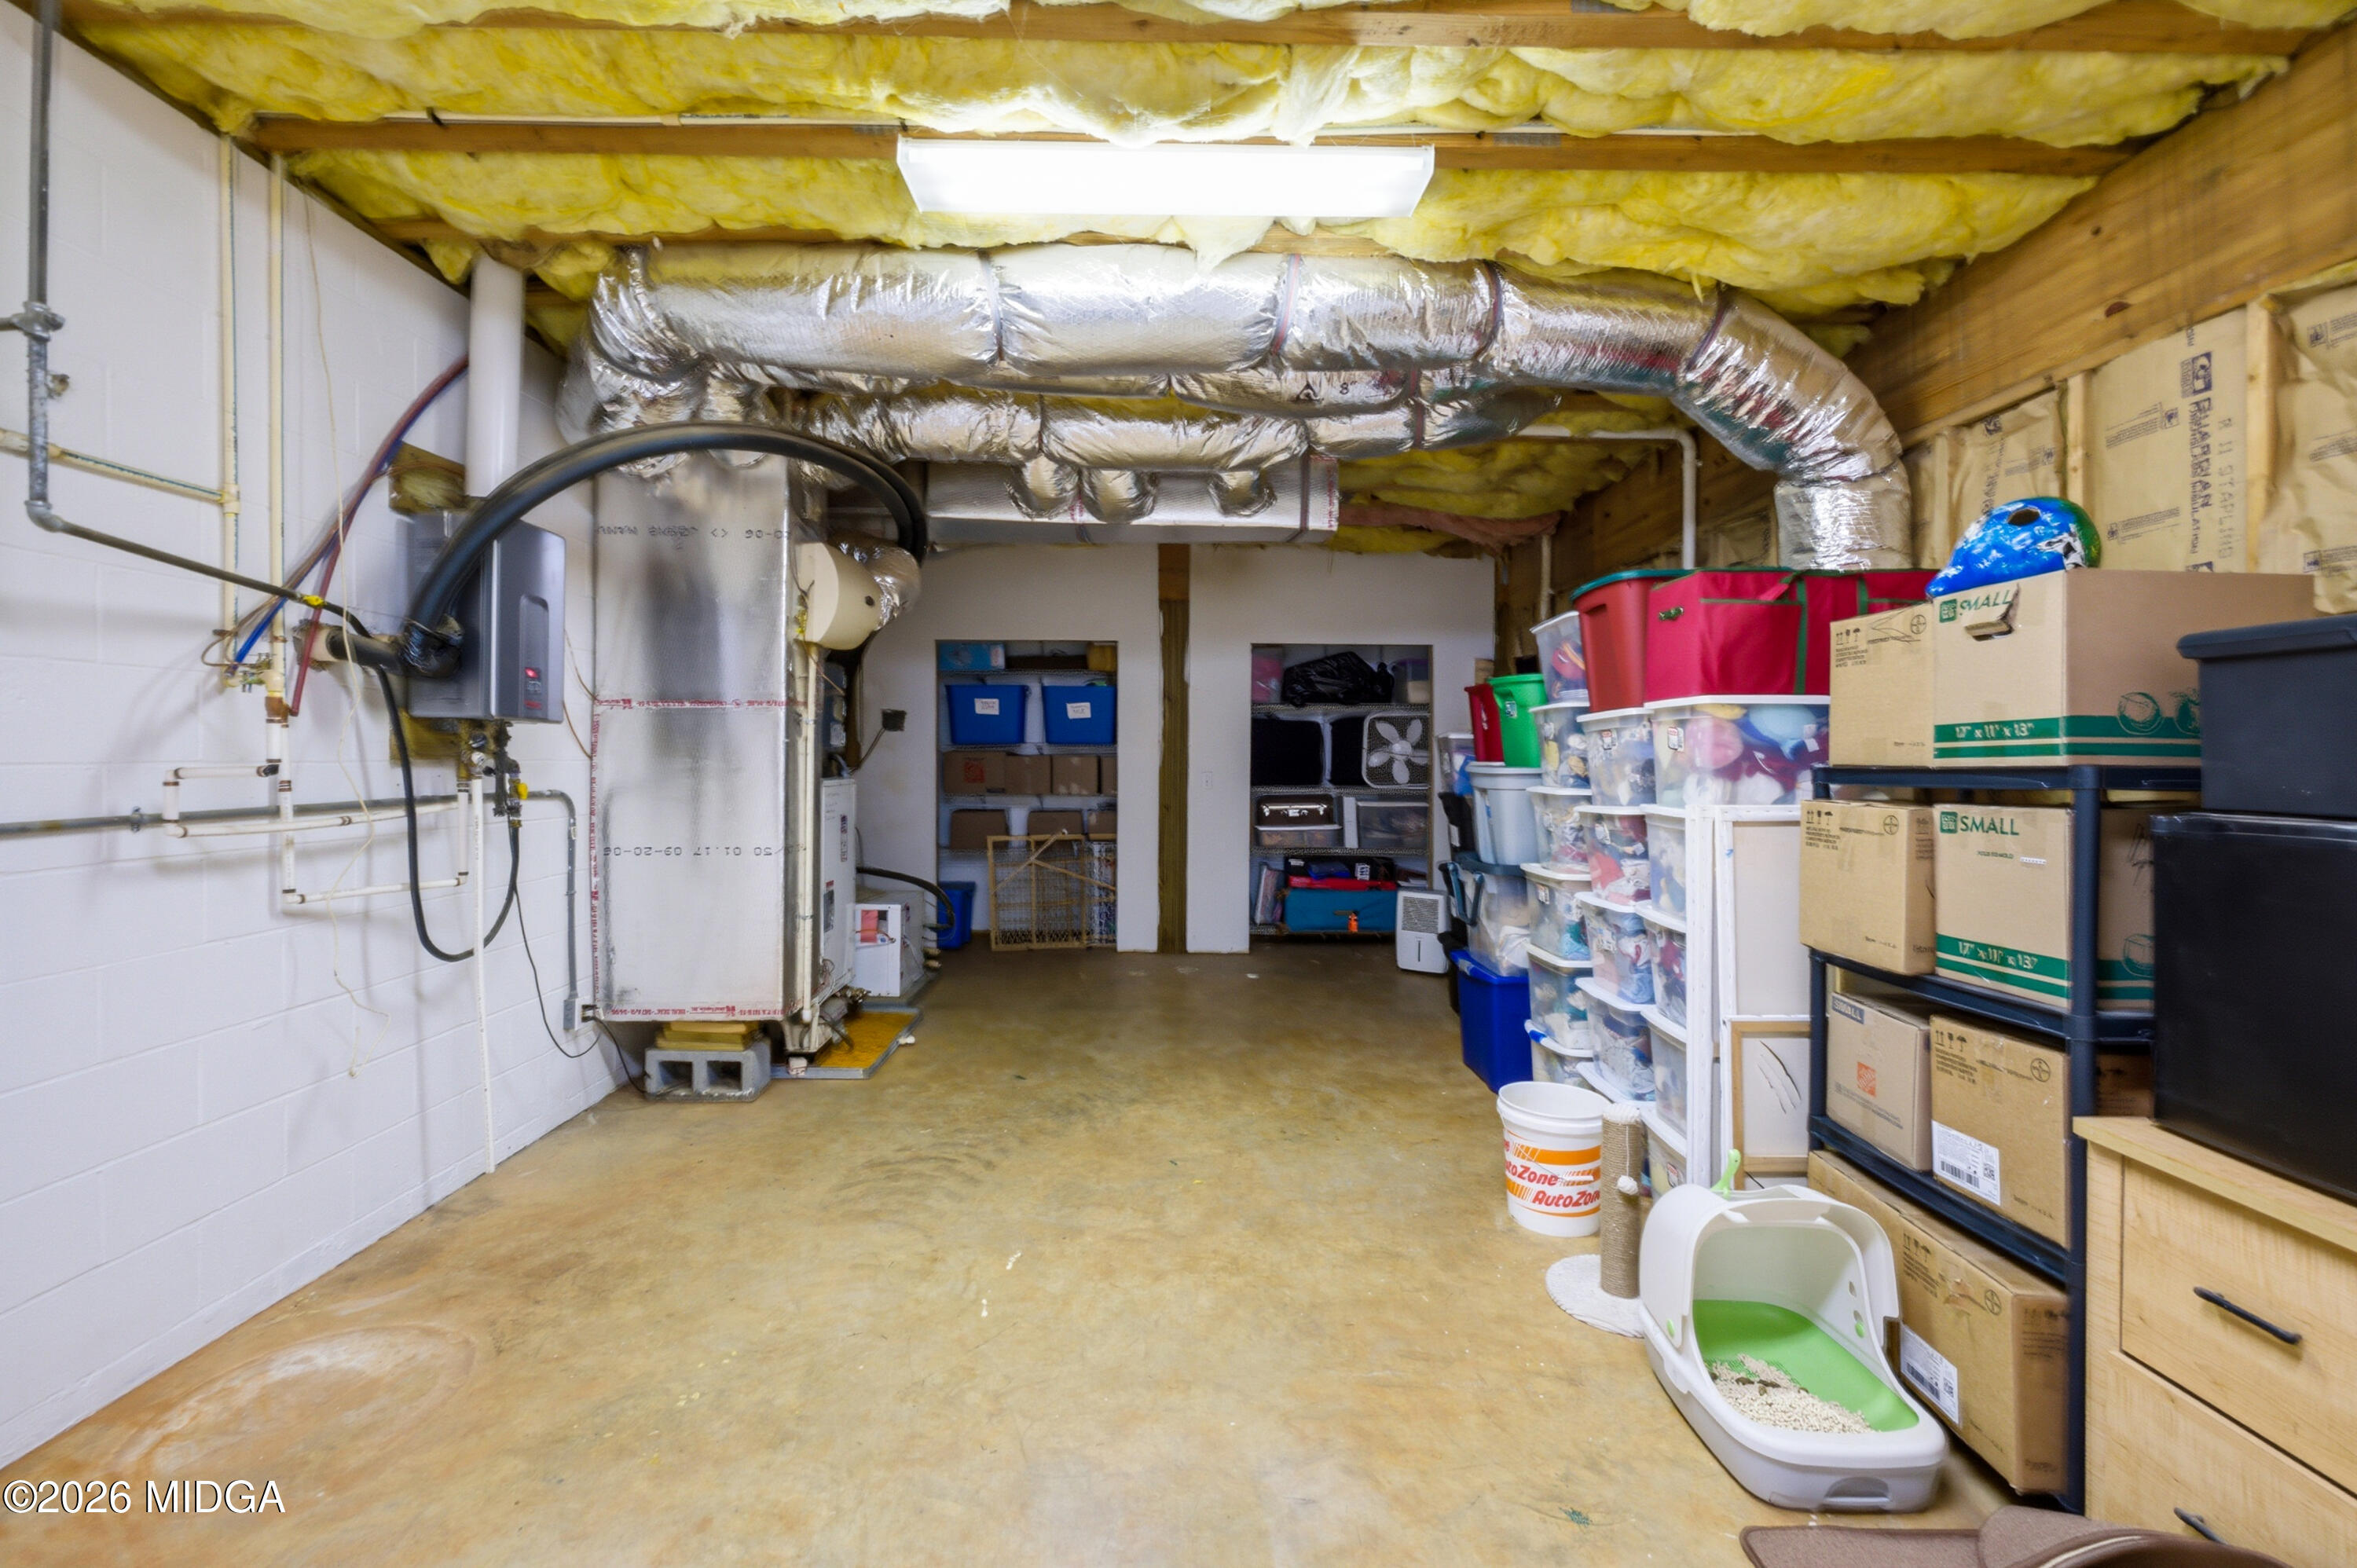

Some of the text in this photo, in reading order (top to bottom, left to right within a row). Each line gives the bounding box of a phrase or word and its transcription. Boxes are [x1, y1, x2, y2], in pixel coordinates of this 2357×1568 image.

[1959, 589, 2013, 614] SMALL
[1959, 815, 2020, 836] SMALL
[1532, 1190, 1600, 1208] AutoZon
